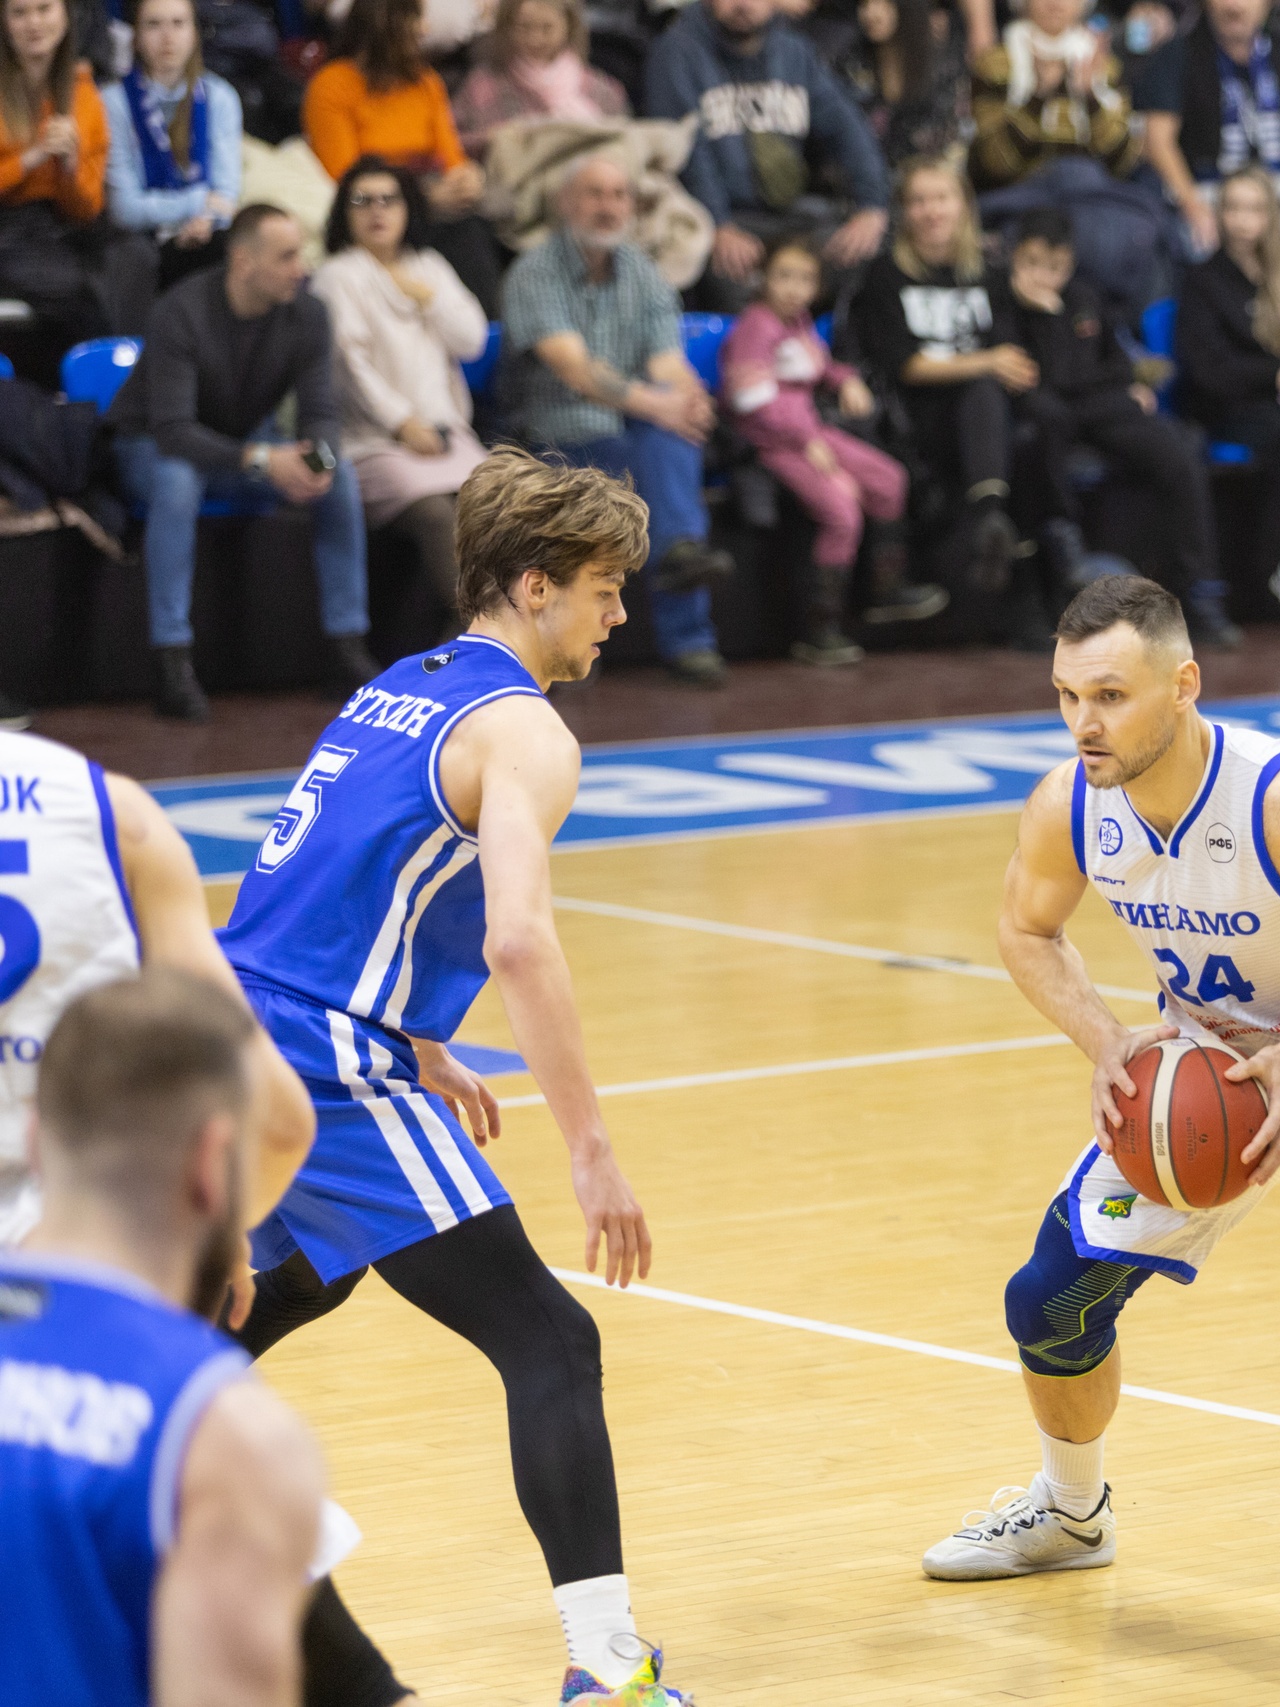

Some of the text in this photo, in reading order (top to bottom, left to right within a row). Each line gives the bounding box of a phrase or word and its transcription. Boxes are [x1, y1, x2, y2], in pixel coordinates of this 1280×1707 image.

[256, 743, 359, 874] 5
[1208, 837, 1233, 850] РФБ
[1152, 947, 1256, 1008] 24
